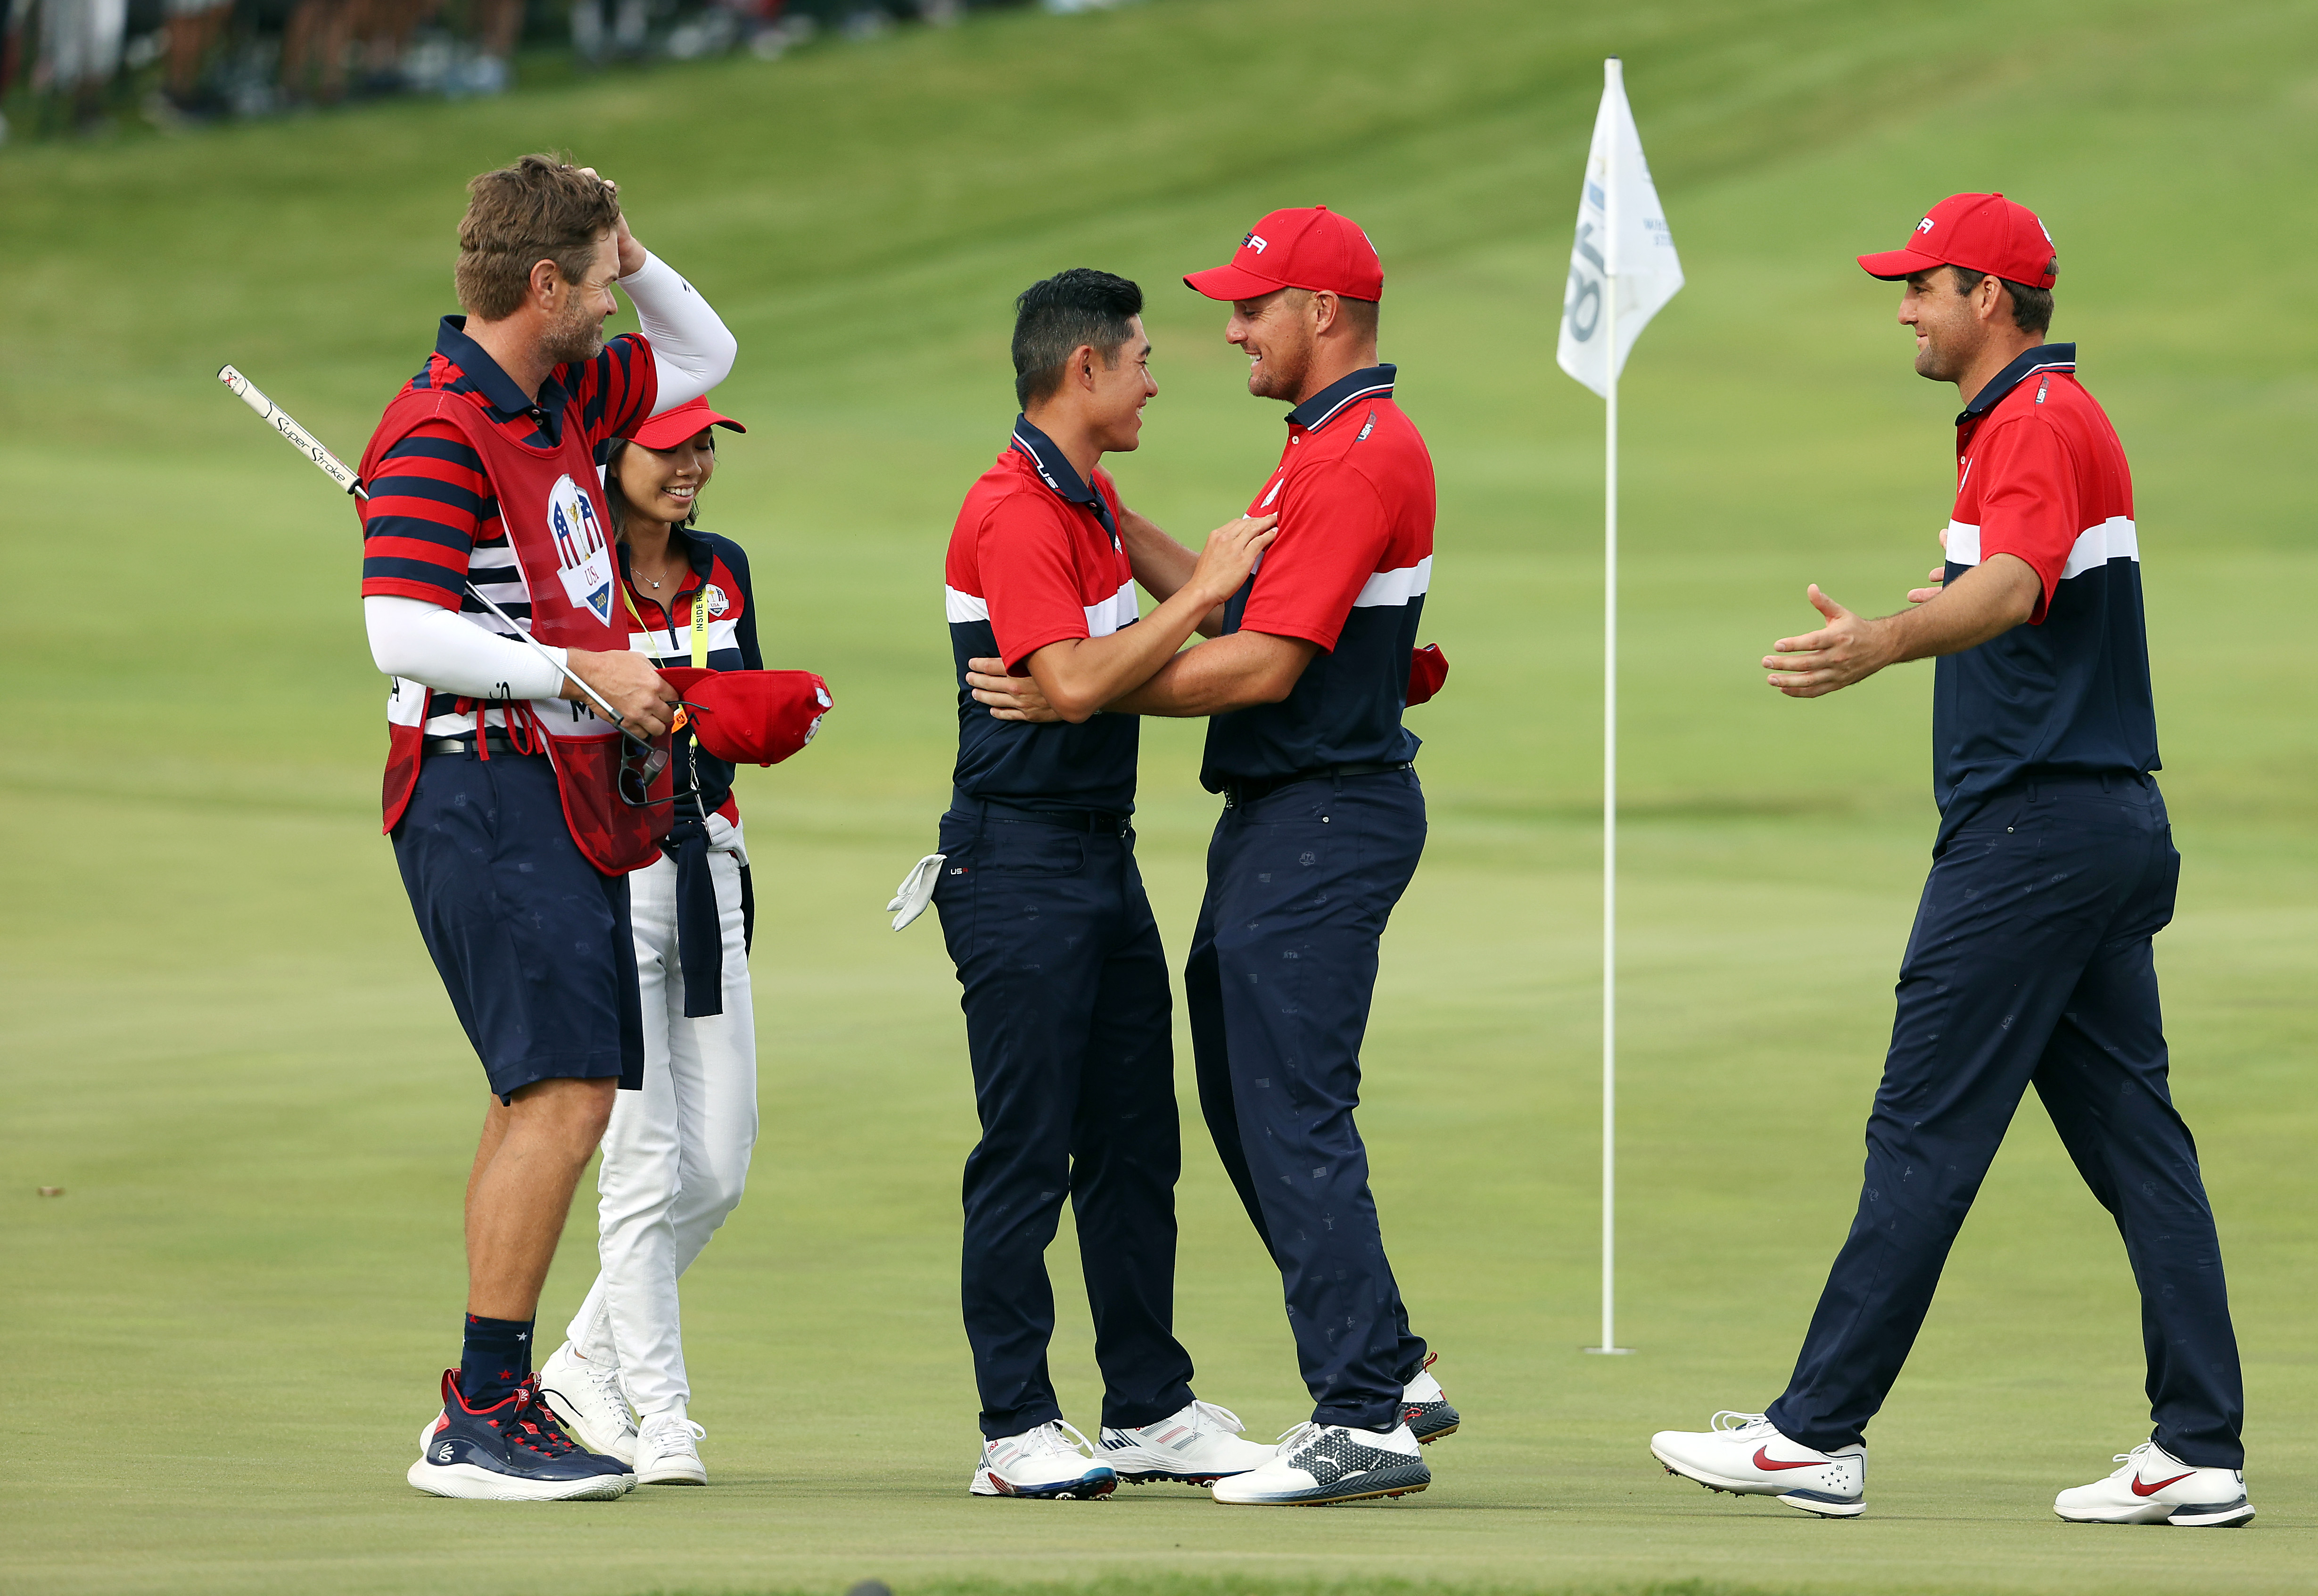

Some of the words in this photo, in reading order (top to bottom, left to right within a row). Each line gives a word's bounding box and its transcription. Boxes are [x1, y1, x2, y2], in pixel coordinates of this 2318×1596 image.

[2036, 388, 2047, 403] USA
[1358, 423, 1373, 440] USA
[278, 417, 310, 449] Super
[312, 447, 345, 482] Stroke
[950, 867, 969, 875] USA
[988, 1440, 998, 1453] USA
